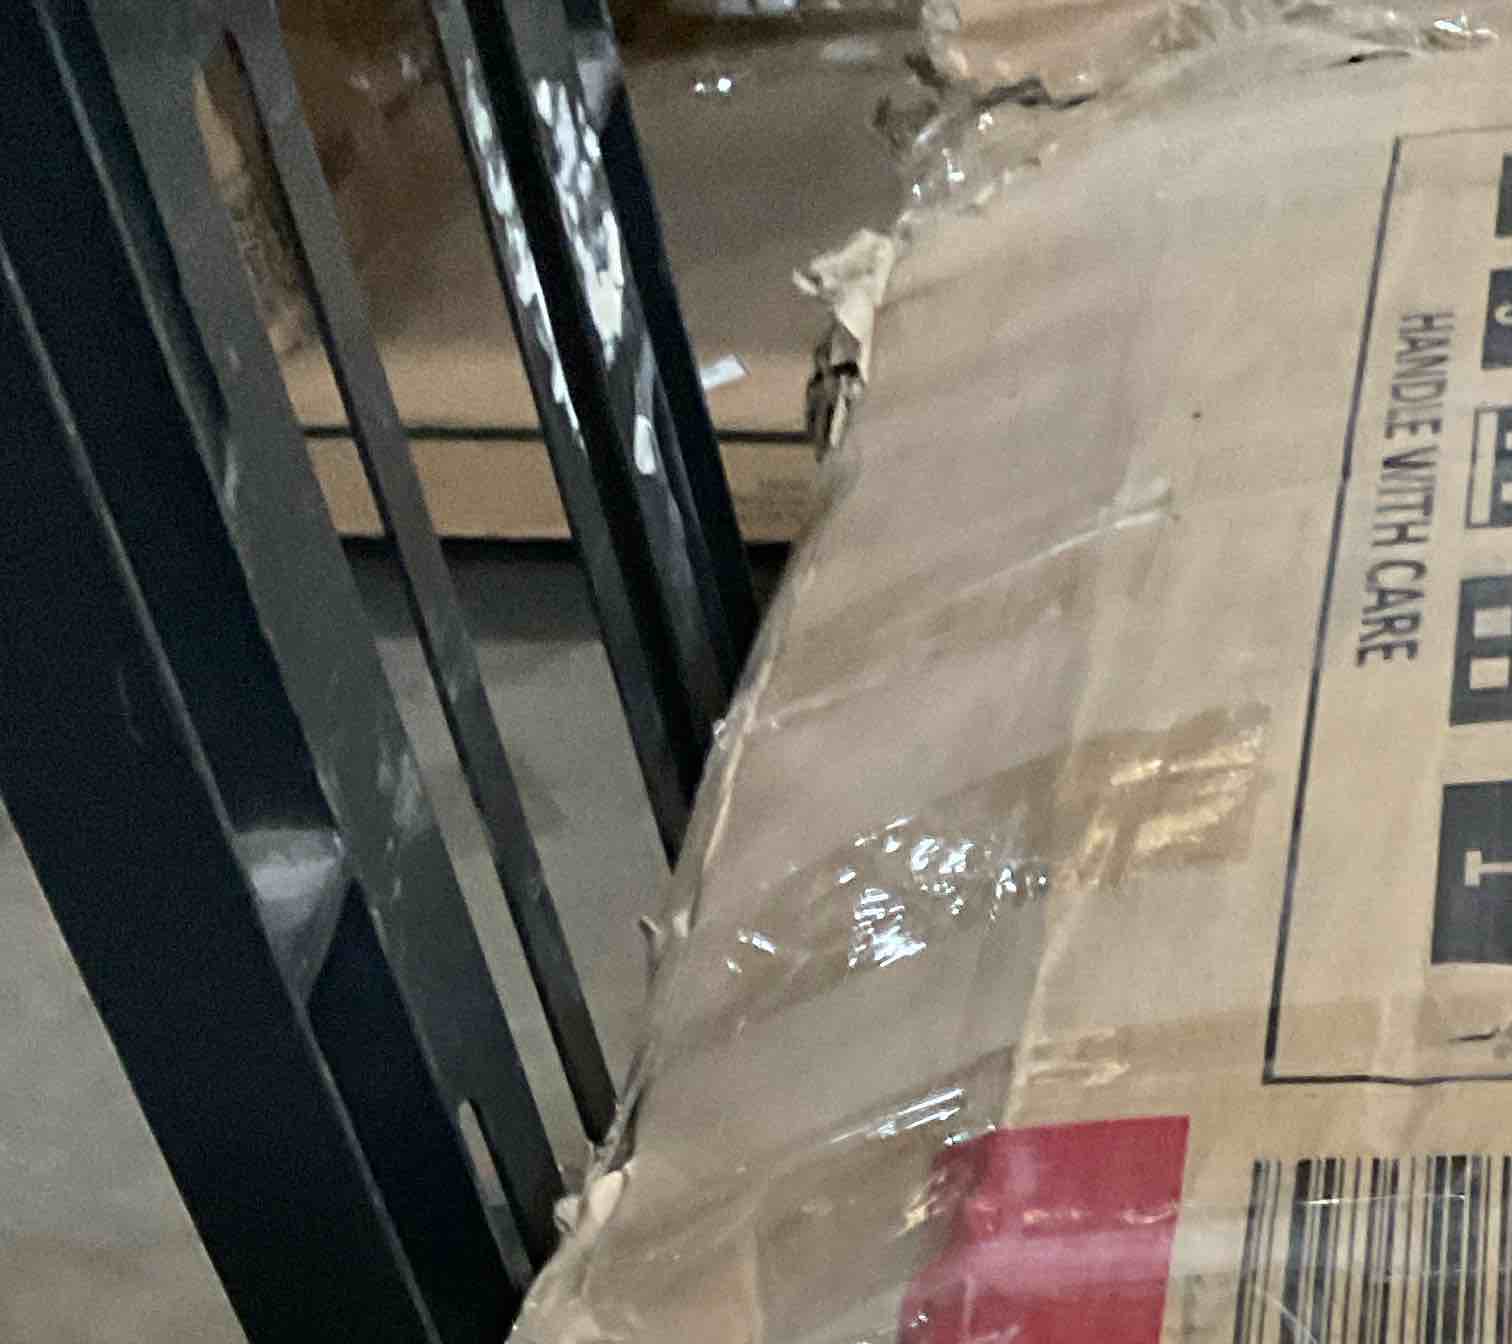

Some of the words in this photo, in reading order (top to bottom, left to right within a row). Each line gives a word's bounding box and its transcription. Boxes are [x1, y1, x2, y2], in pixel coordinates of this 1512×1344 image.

[1384, 311, 1454, 439] HANDLE
[1372, 444, 1440, 547] WITH
[1356, 559, 1428, 668] CARE
